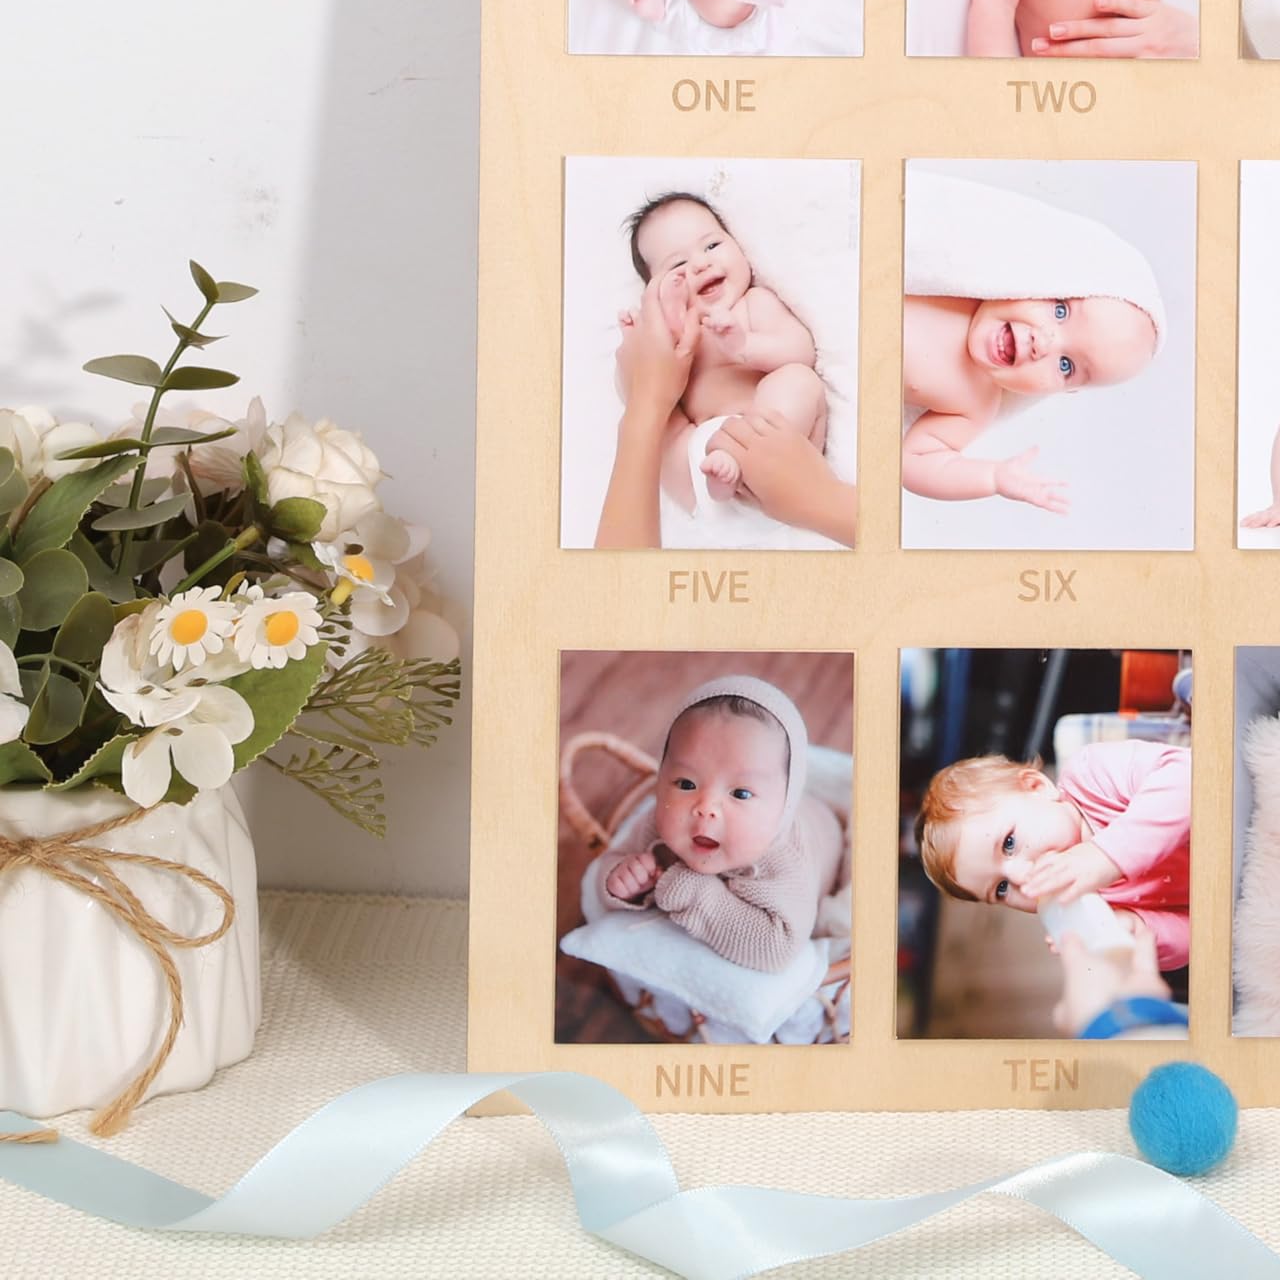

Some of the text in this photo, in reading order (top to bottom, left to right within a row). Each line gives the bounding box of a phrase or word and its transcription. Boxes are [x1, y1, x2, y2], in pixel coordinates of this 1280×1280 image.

[671, 79, 757, 113] ONE
[1006, 80, 1097, 113] TWO
[669, 570, 750, 603] FIVE
[1018, 569, 1077, 603] SIX
[655, 1063, 751, 1097] NINE
[1003, 1059, 1080, 1093] TEN
